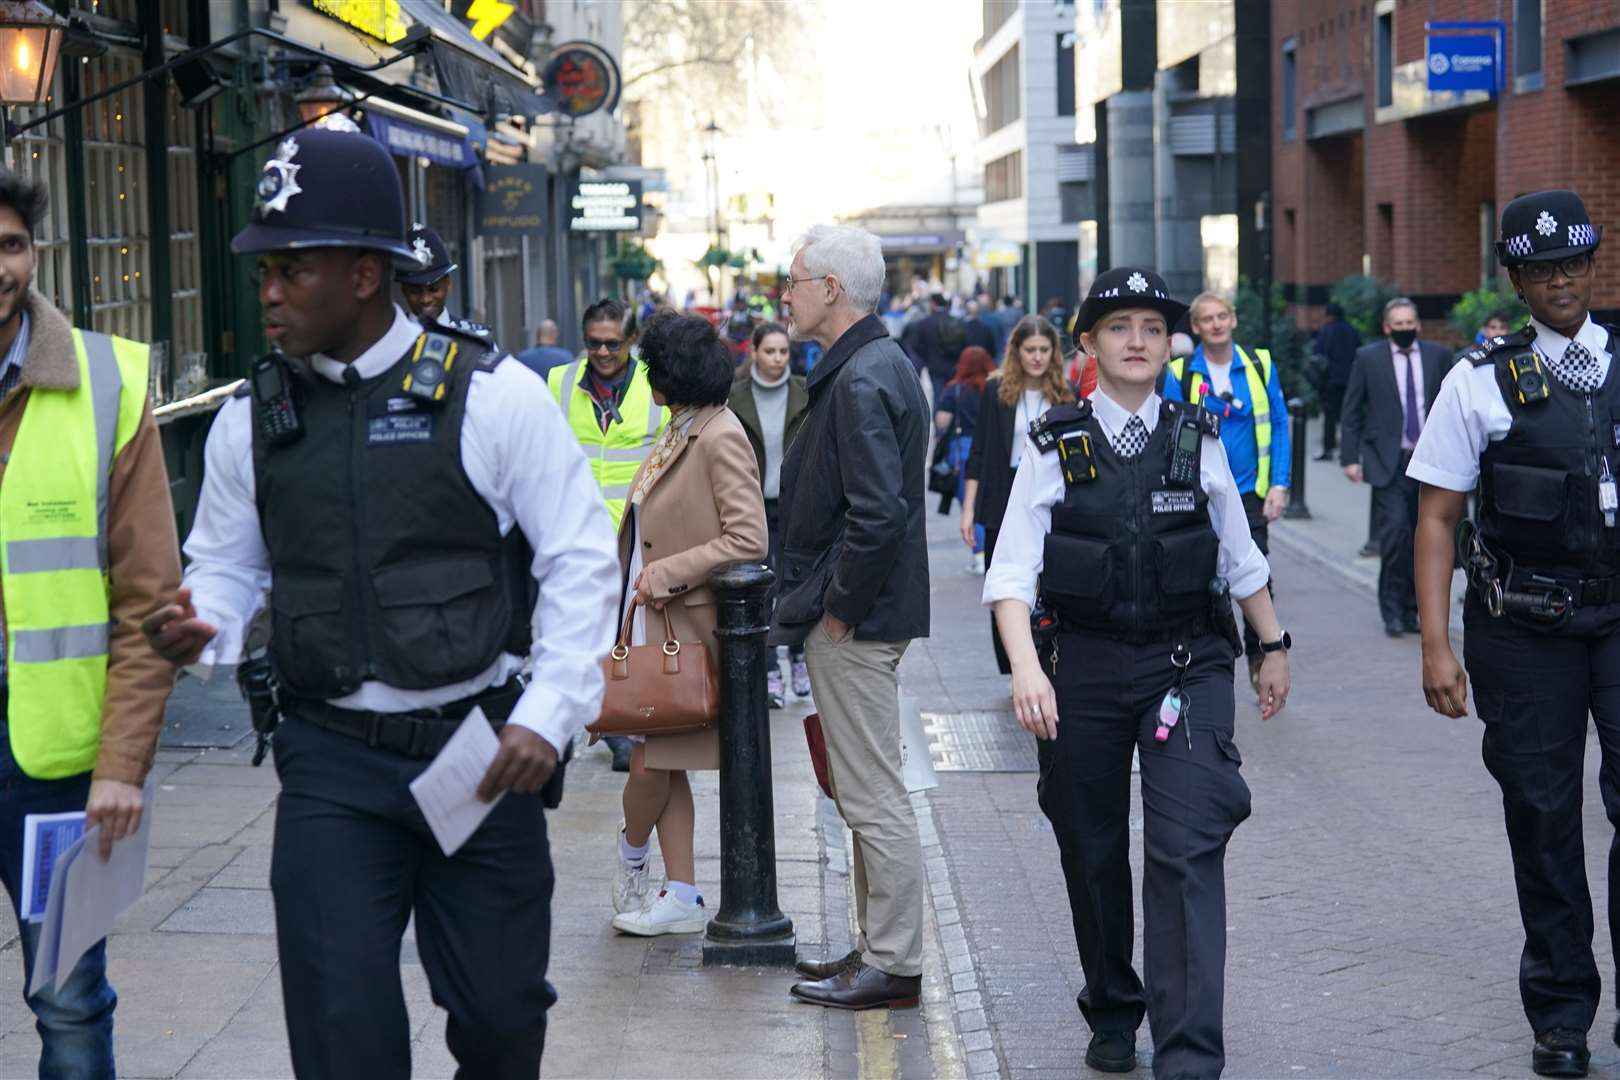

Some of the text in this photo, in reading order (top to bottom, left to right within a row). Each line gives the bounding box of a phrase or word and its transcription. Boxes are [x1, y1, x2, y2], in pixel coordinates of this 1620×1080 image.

[369, 431, 431, 442] POLICE OFFICER
[1153, 503, 1195, 512] POLICE OFFICER
